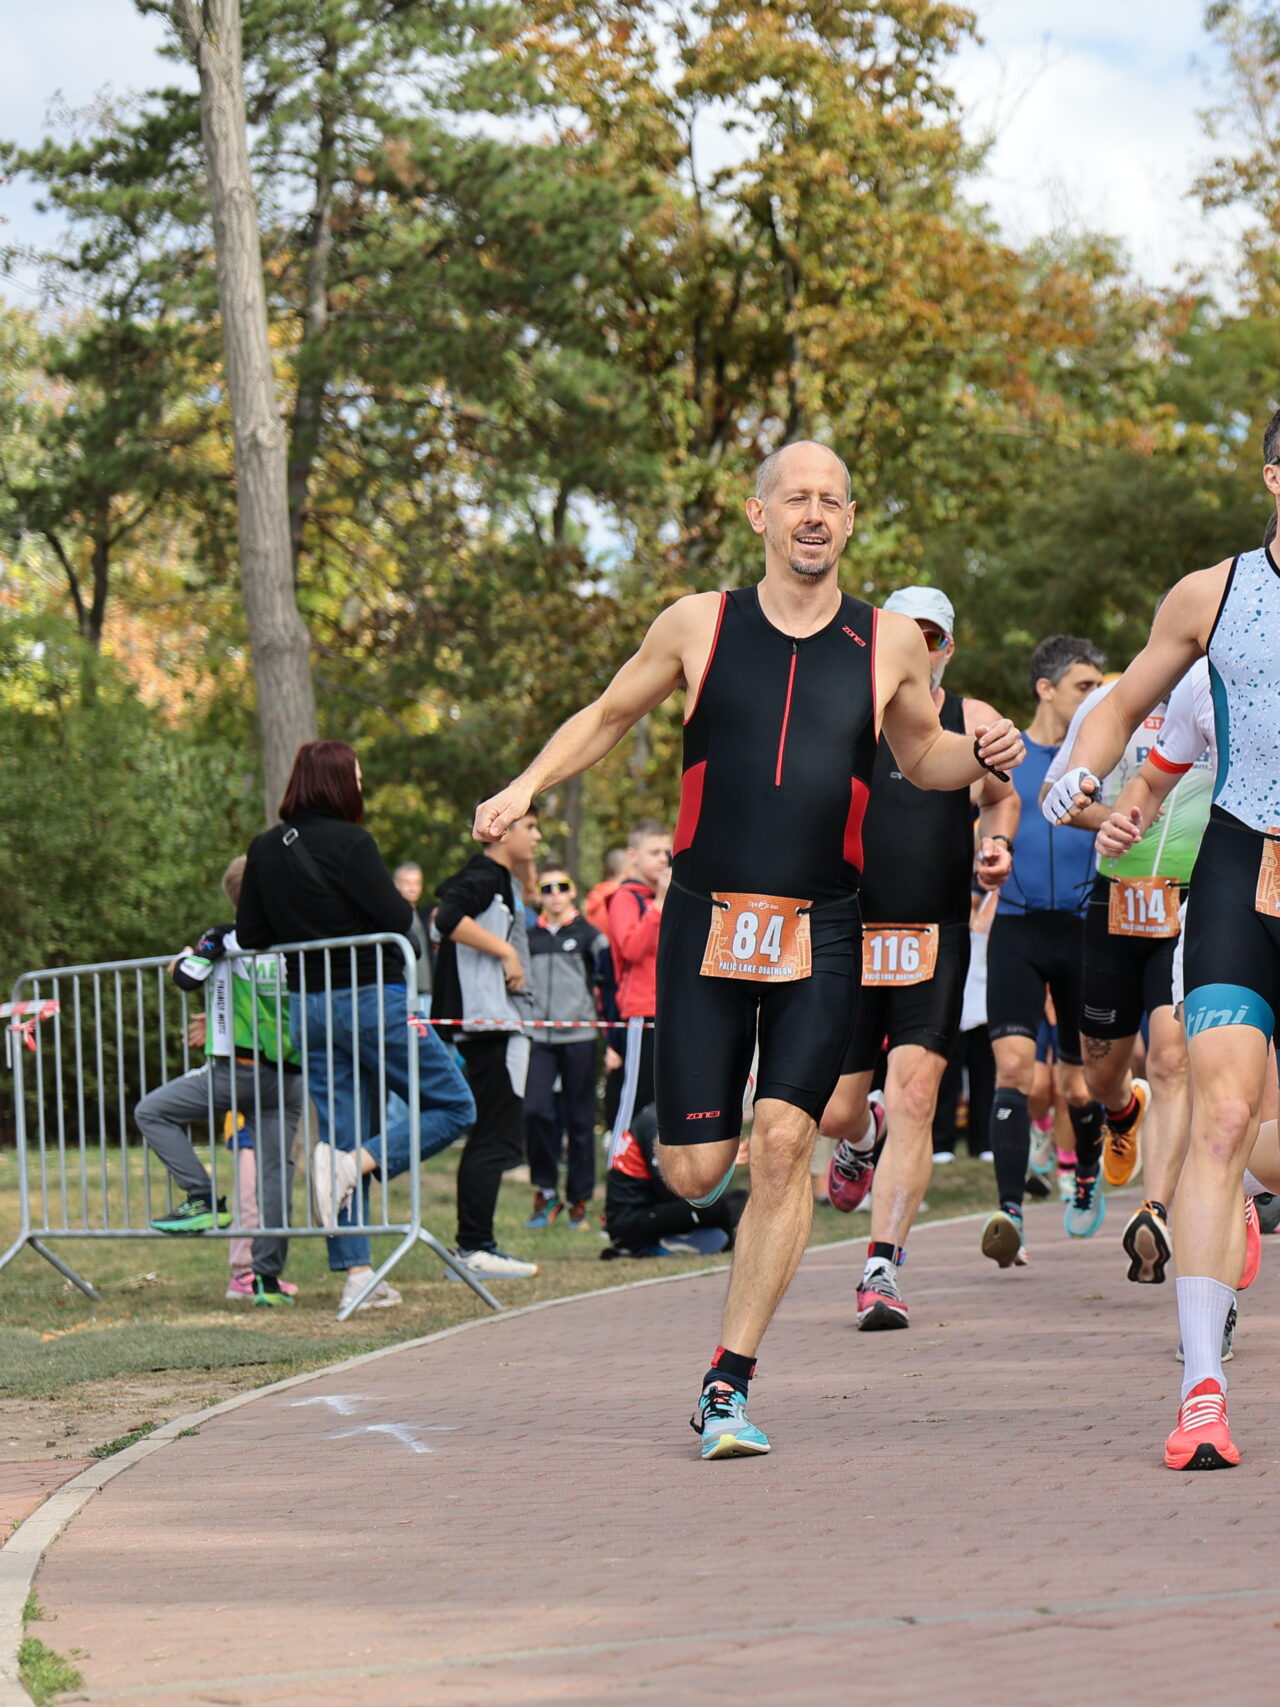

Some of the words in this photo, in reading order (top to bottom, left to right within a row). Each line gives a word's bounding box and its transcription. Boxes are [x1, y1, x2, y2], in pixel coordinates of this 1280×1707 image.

[1124, 888, 1167, 923] 114
[732, 911, 785, 963] 84
[870, 935, 920, 972] 116
[739, 963, 756, 974] LAKE
[758, 965, 793, 976] DUATHLON
